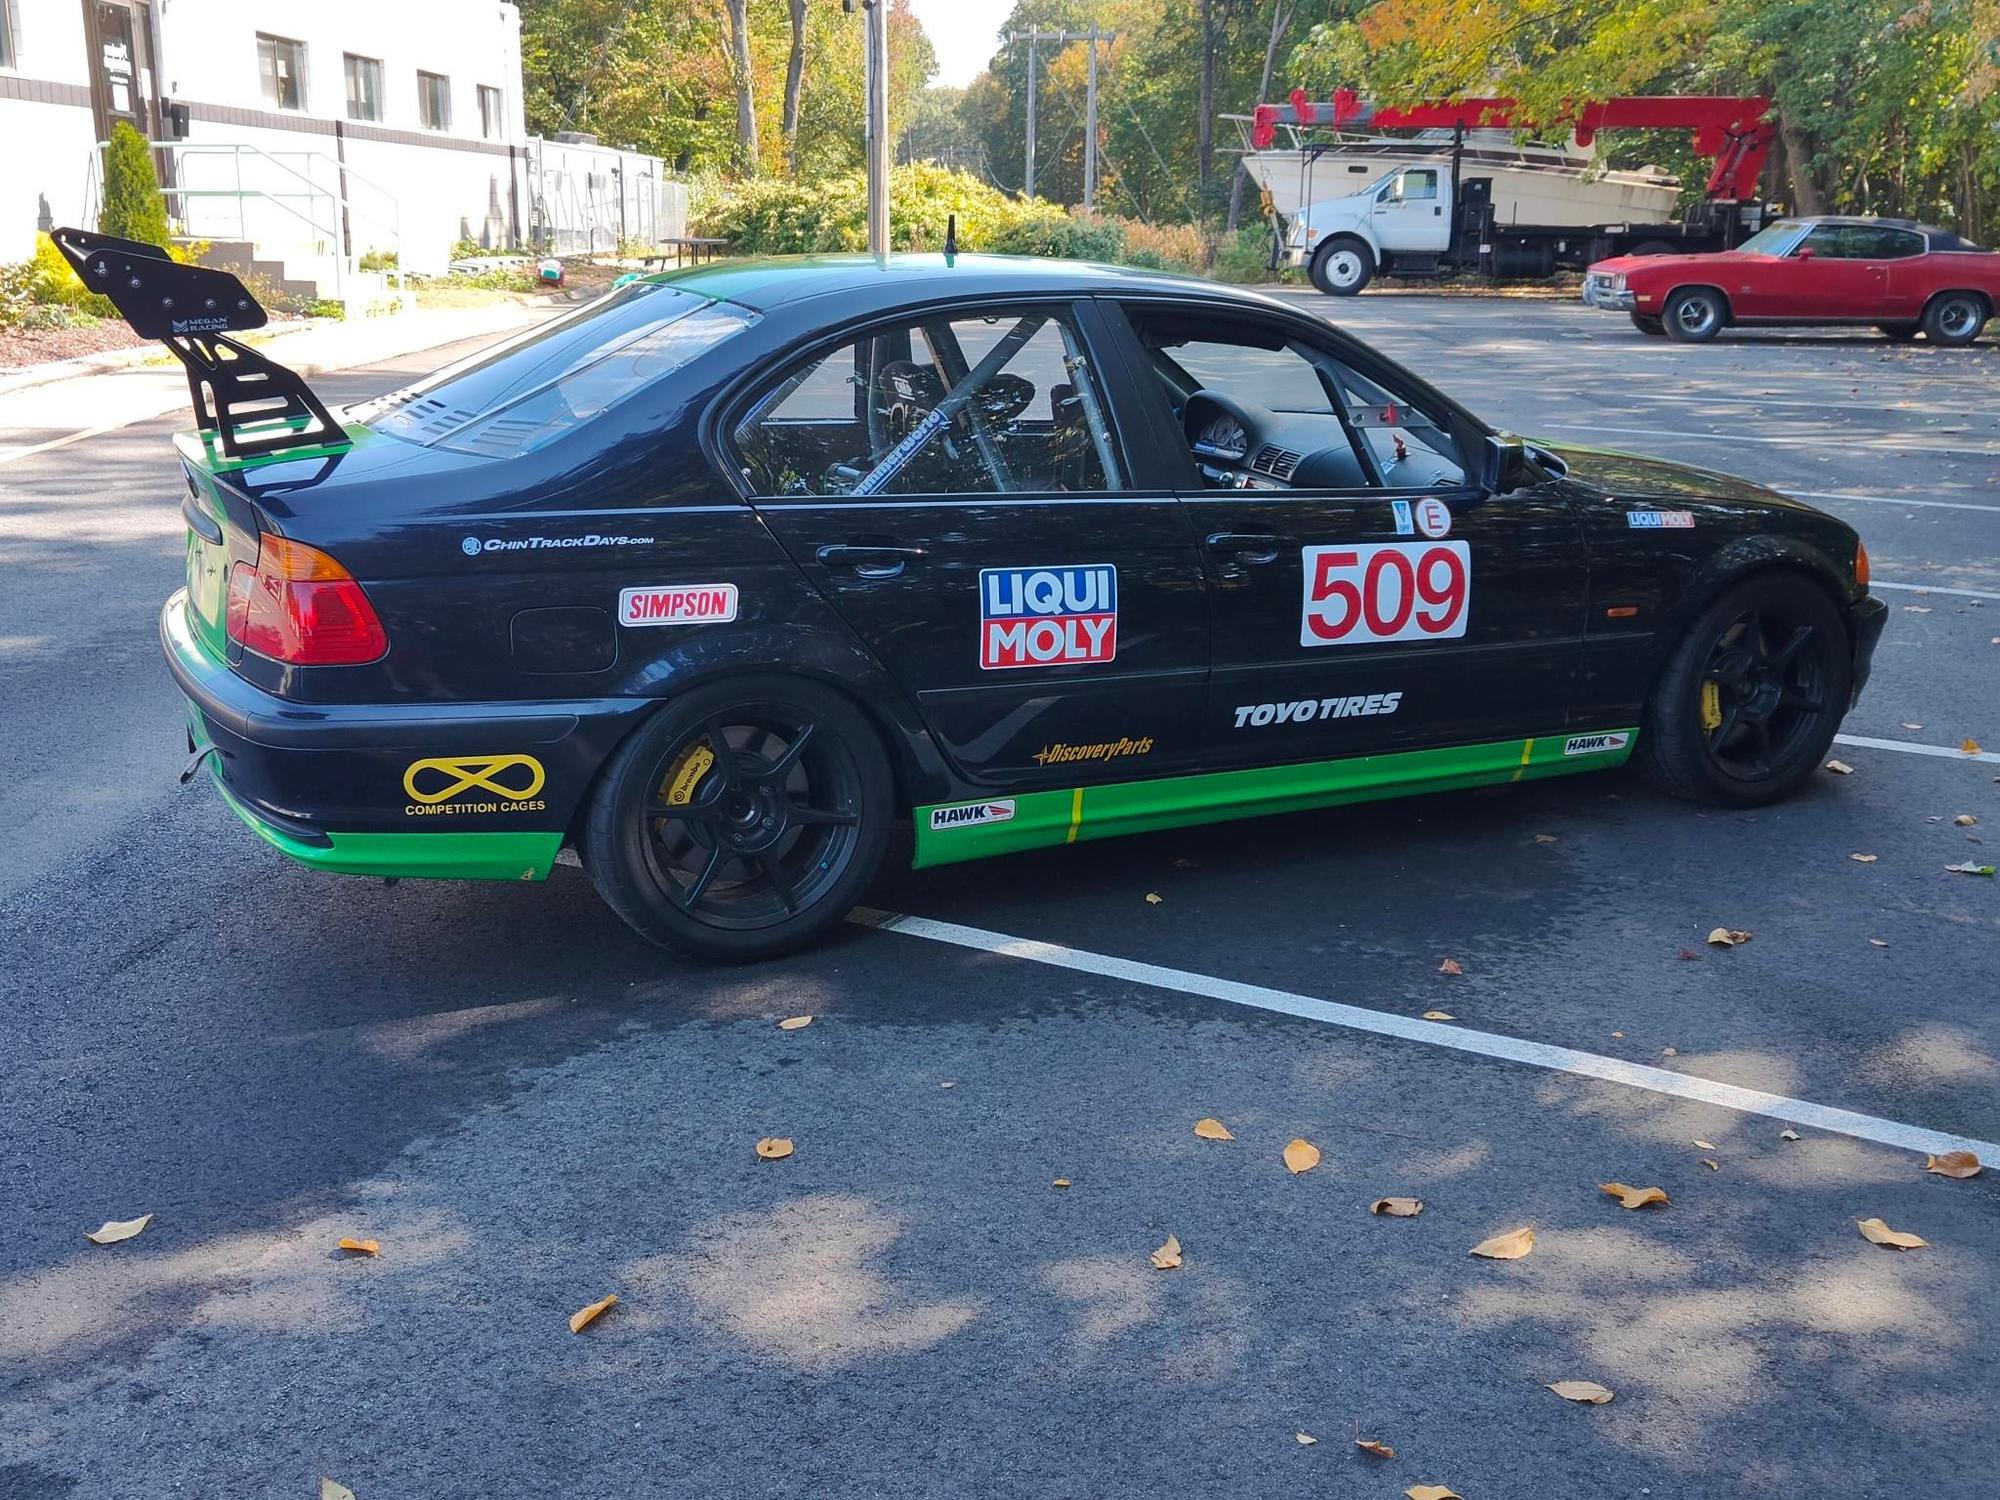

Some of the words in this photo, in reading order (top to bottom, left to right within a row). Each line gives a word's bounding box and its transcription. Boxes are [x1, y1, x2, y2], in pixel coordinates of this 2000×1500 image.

[189, 317, 228, 325] MEGAN
[189, 323, 228, 331] RACING
[1424, 505, 1443, 530] E
[1629, 512, 1662, 526] LIQUI
[1660, 512, 1692, 526] MOLY
[629, 591, 727, 619] SIMPSON
[988, 570, 1109, 616] LIQUI
[1307, 547, 1466, 640] 509
[988, 617, 1114, 664] MOLY
[1234, 699, 1319, 728] TOYO
[1318, 692, 1404, 720] TIRES
[1046, 736, 1154, 763] DiscoveryParts
[1567, 736, 1607, 751] HAWK
[680, 762, 701, 791] brembo
[405, 802, 497, 816] COMPETITION
[500, 800, 546, 812] CAGES
[934, 805, 987, 824] HAWK
